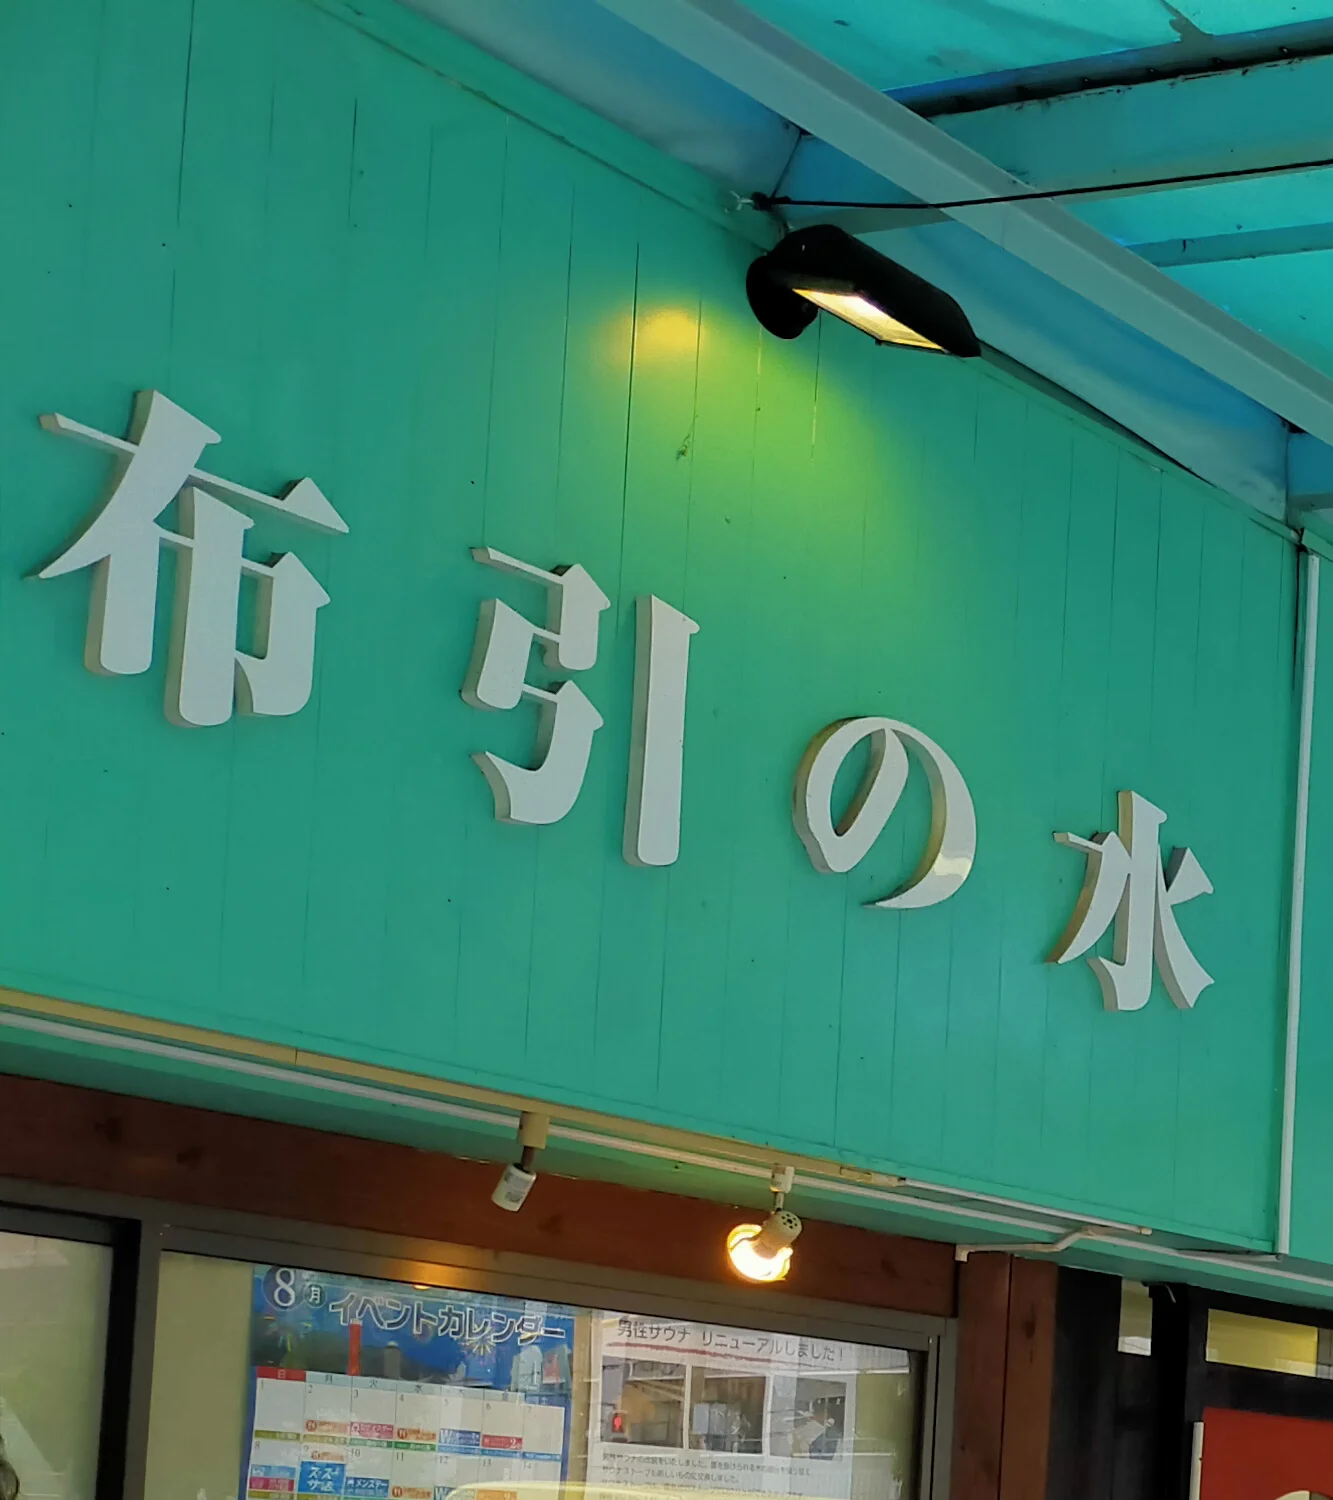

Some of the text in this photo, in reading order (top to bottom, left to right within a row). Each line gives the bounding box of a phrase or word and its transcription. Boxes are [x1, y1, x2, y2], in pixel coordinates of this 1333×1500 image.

[25, 388, 1216, 1012] 布引の水
[329, 1292, 566, 1346] イベントカレンダー
[617, 1319, 692, 1343] 男性サウナ
